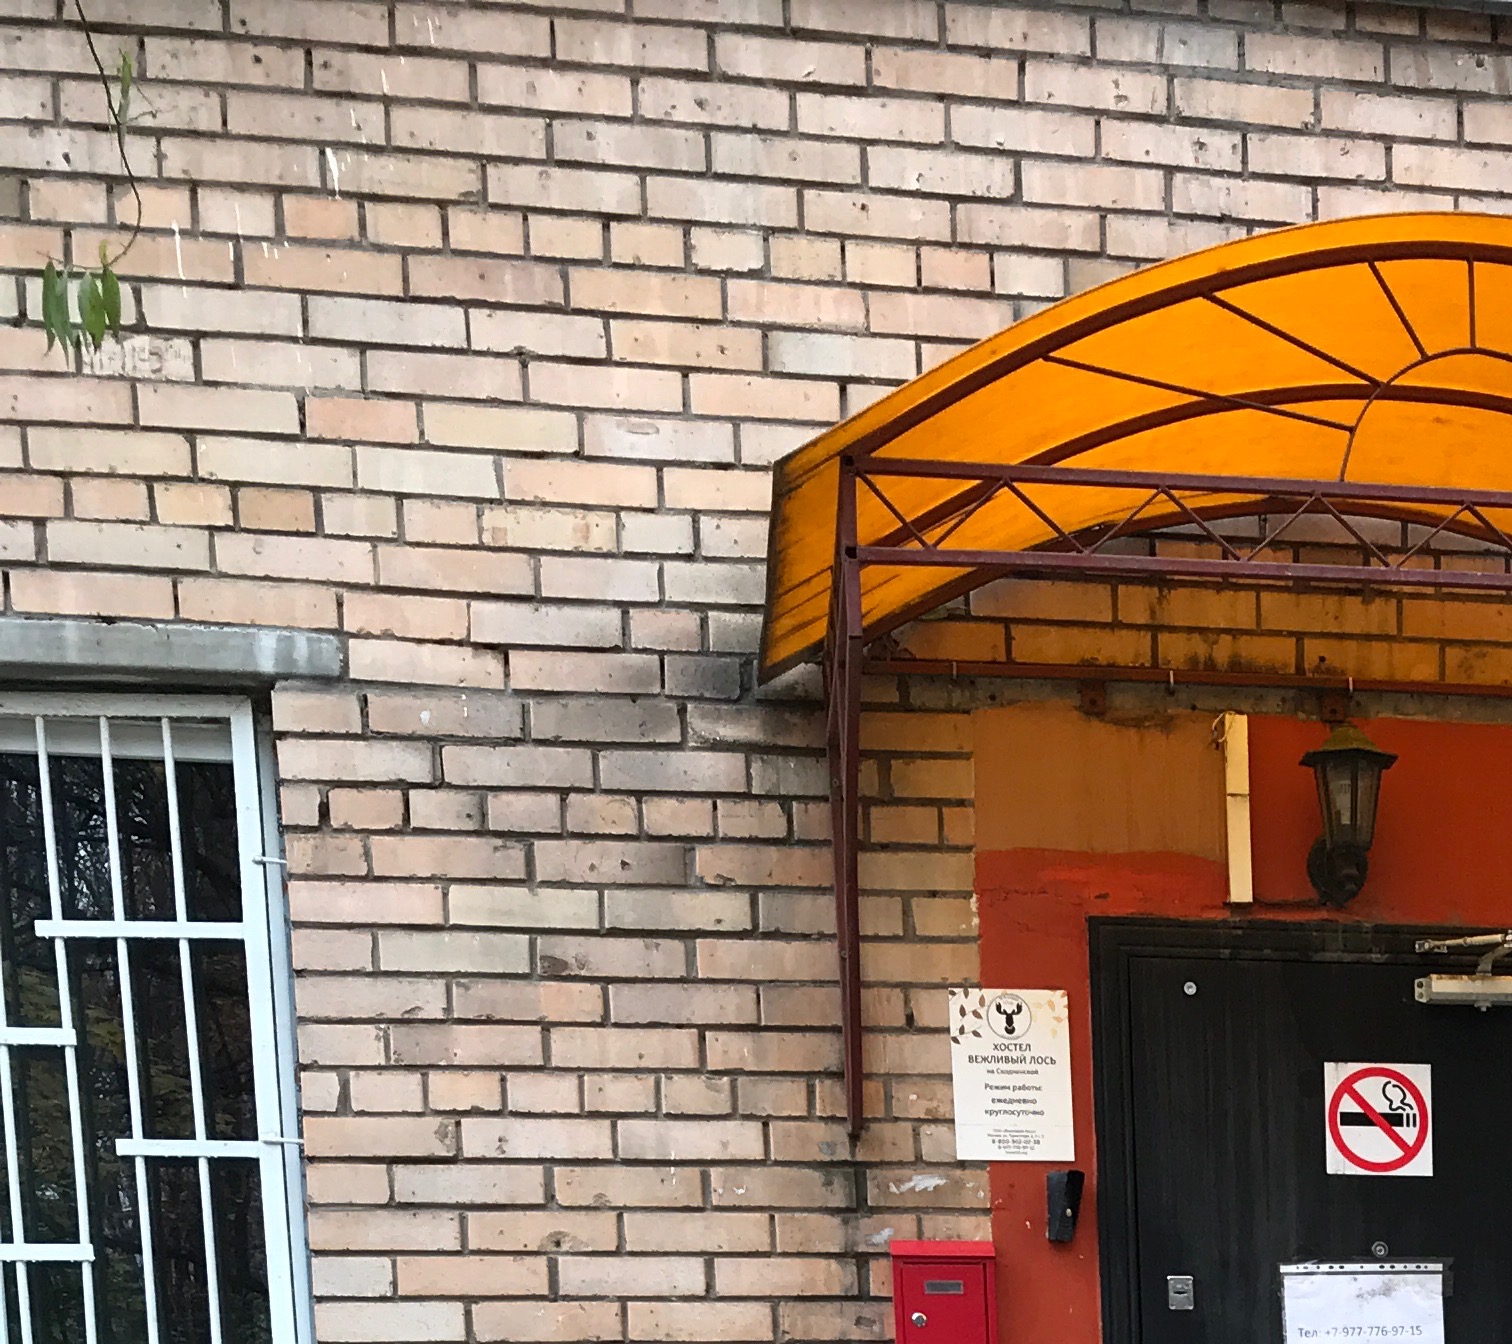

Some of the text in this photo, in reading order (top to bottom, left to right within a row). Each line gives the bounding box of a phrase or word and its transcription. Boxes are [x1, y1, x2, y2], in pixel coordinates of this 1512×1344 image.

[992, 1042, 1032, 1052] ХОСТЕЛ
[967, 1054, 1057, 1065] ВЕЖЛИВЫЙ ЛОСЬ
[984, 1083, 1011, 1091] Режим
[991, 1097, 1037, 1105] ежедневно
[984, 1109, 1045, 1118] круглосуточно
[1325, 1325, 1423, 1337] +7-977-776-97-15
